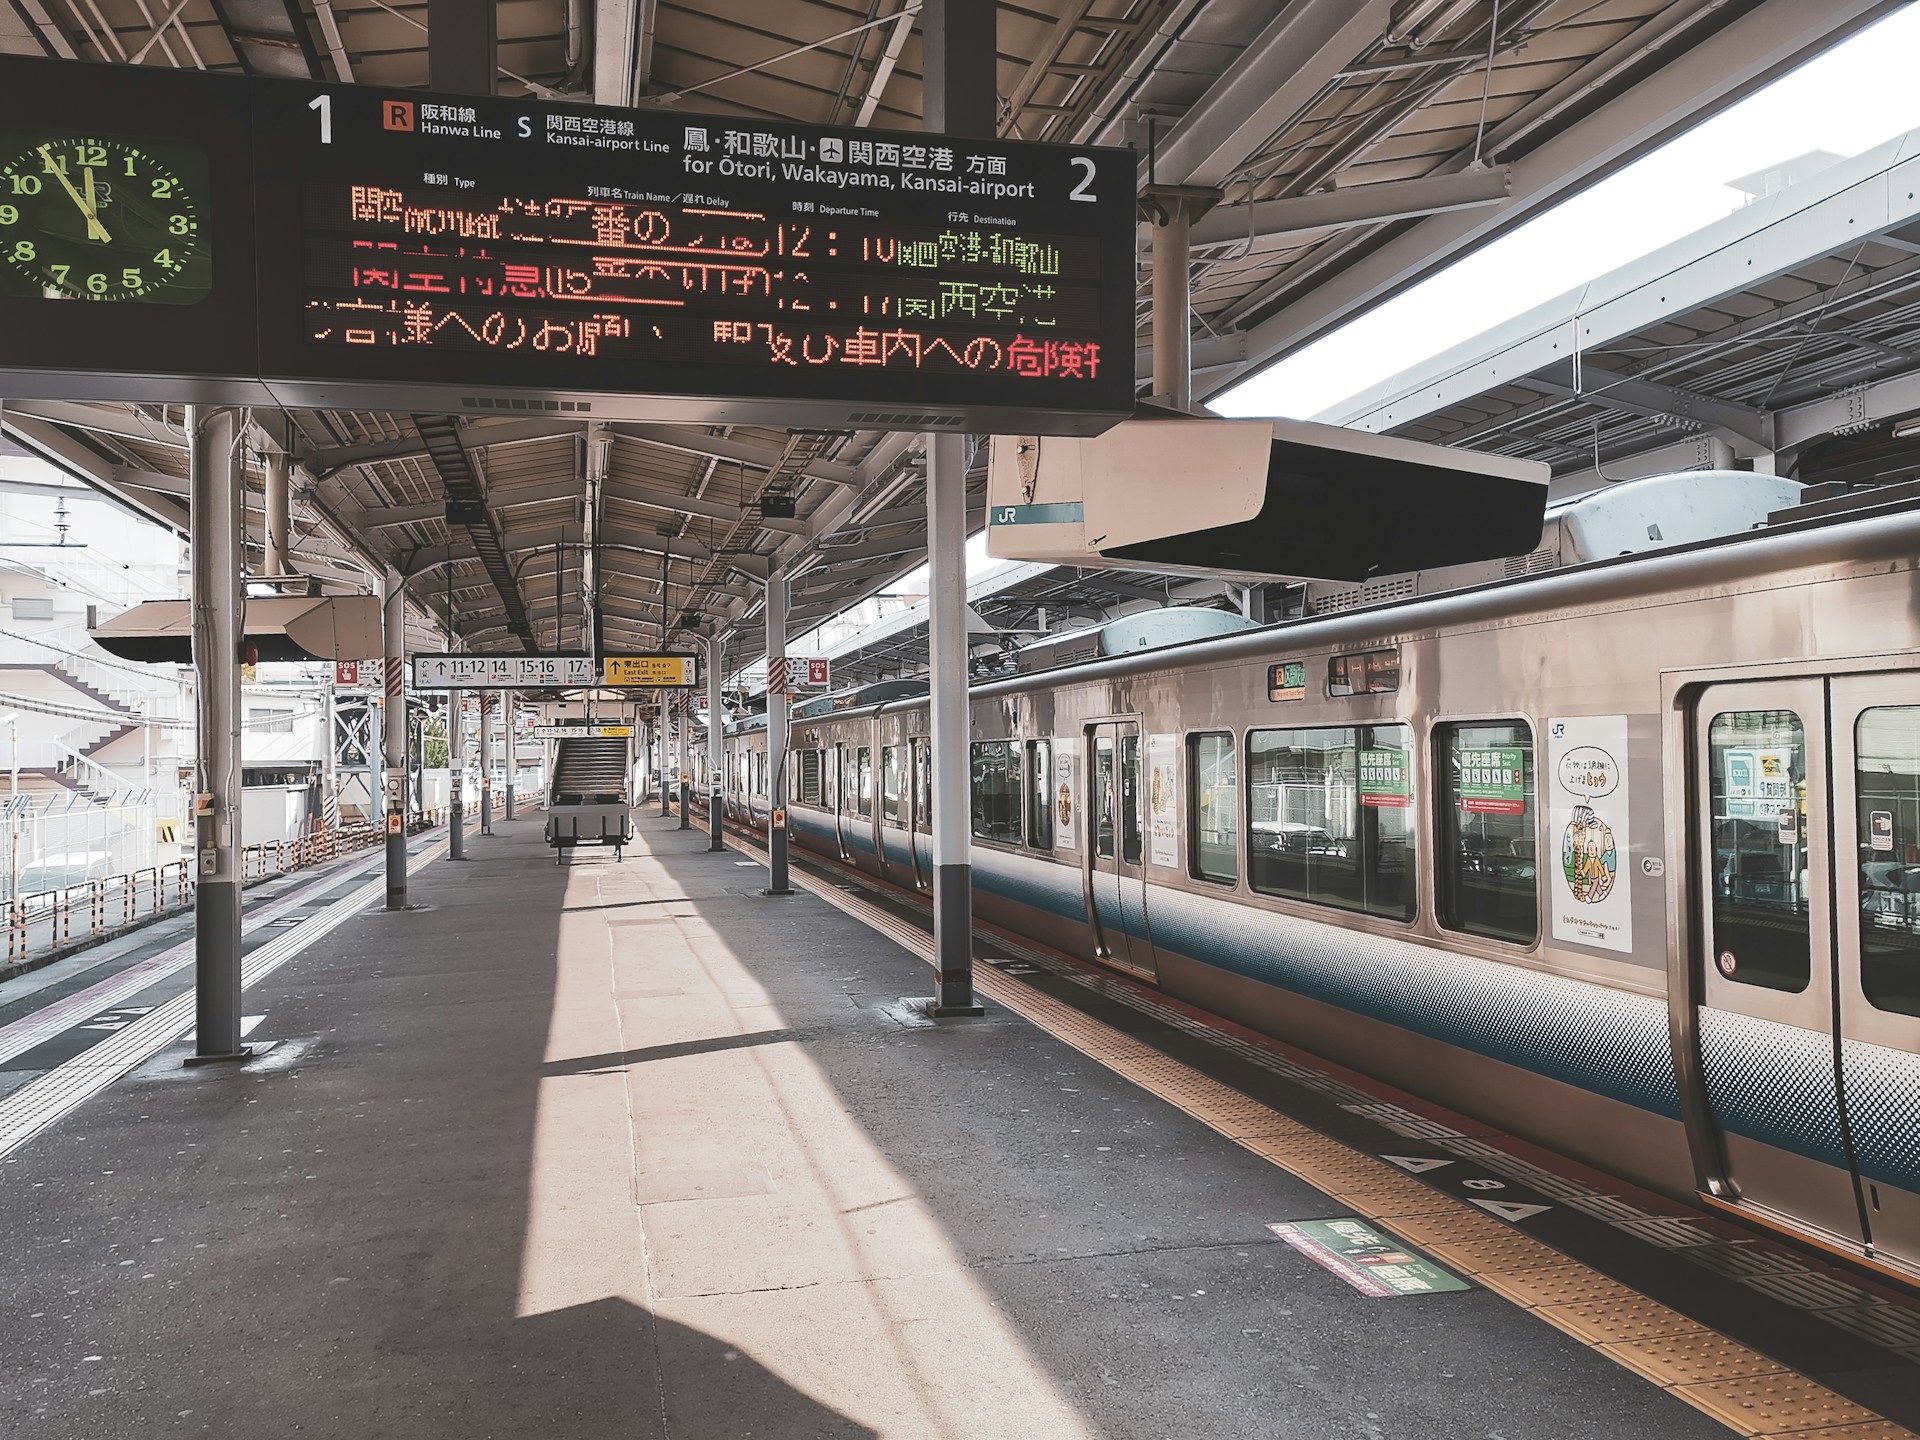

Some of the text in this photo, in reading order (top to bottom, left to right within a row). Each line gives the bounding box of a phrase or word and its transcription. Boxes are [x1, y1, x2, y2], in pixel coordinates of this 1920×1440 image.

[308, 94, 332, 144] 1
[389, 103, 477, 128] R 阪和線
[517, 114, 635, 138] S 関西空港線
[421, 121, 501, 140] Hanwa Line
[546, 132, 670, 154] Kansai-airport Line
[75, 145, 109, 168] 12
[123, 156, 137, 177] 1
[848, 140, 954, 172] 関西空港
[965, 154, 1007, 176] 方面
[9, 174, 43, 196] 10
[423, 172, 476, 189] 種別 Type
[682, 154, 1036, 200] for Ōtori, Wakayama, Kansai-airport
[1068, 156, 1098, 203] 2
[151, 178, 172, 199] 2
[587, 185, 623, 199] 列車名
[624, 190, 645, 201] Train
[646, 192, 671, 203] Name
[682, 193, 705, 204] 遅れ
[706, 196, 730, 208] Delay
[0, 204, 19, 226] 9
[792, 201, 880, 218] 時刻 Departure Time
[947, 211, 1017, 227] 行先 Destination
[168, 214, 189, 236] 3
[13, 240, 37, 262] 8
[153, 248, 175, 269] 4
[50, 264, 71, 285] 7
[86, 273, 108, 294] 6
[121, 267, 143, 289] 5
[998, 507, 1017, 524] JR
[338, 661, 356, 670] SOS
[491, 660, 508, 674] 14
[623, 660, 649, 668] 東出口
[1552, 723, 1565, 735] JR
[1461, 751, 1501, 768] 優先座席
